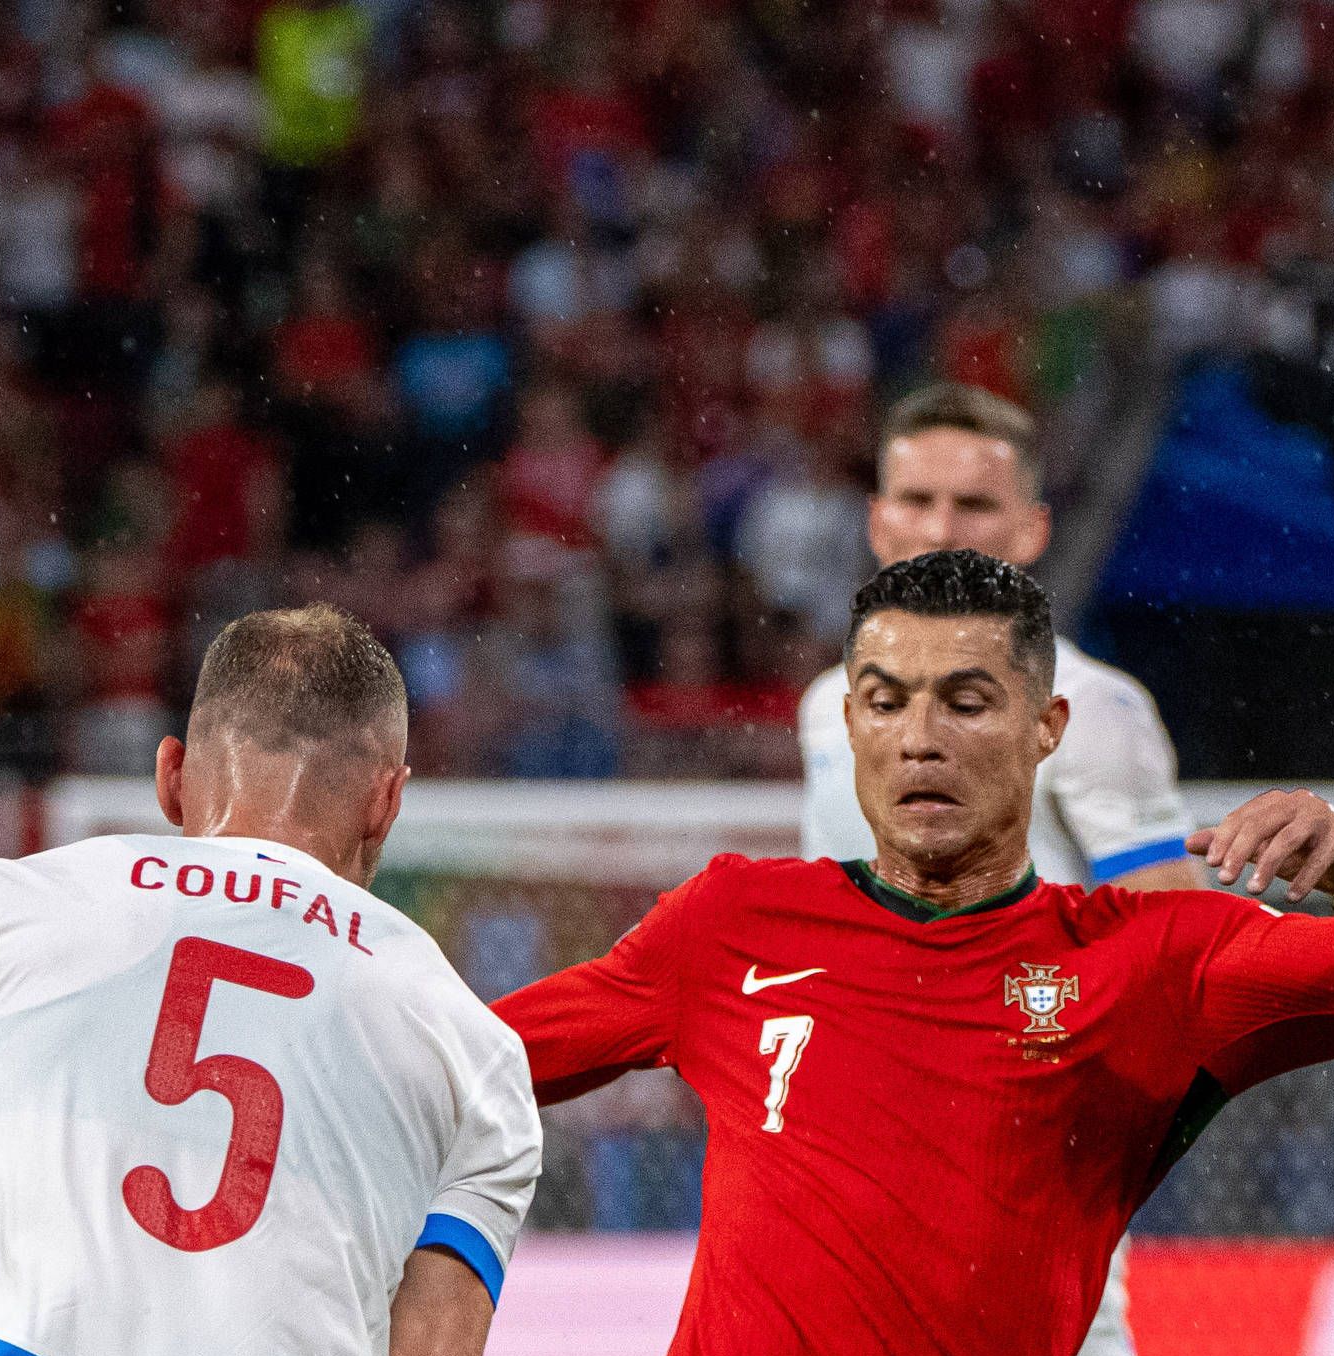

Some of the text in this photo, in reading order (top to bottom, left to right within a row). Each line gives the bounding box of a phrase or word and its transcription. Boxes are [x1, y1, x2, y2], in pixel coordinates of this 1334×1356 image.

[130, 856, 373, 956] COUFAL
[122, 936, 315, 1252] 5
[759, 1015, 814, 1133] 7
